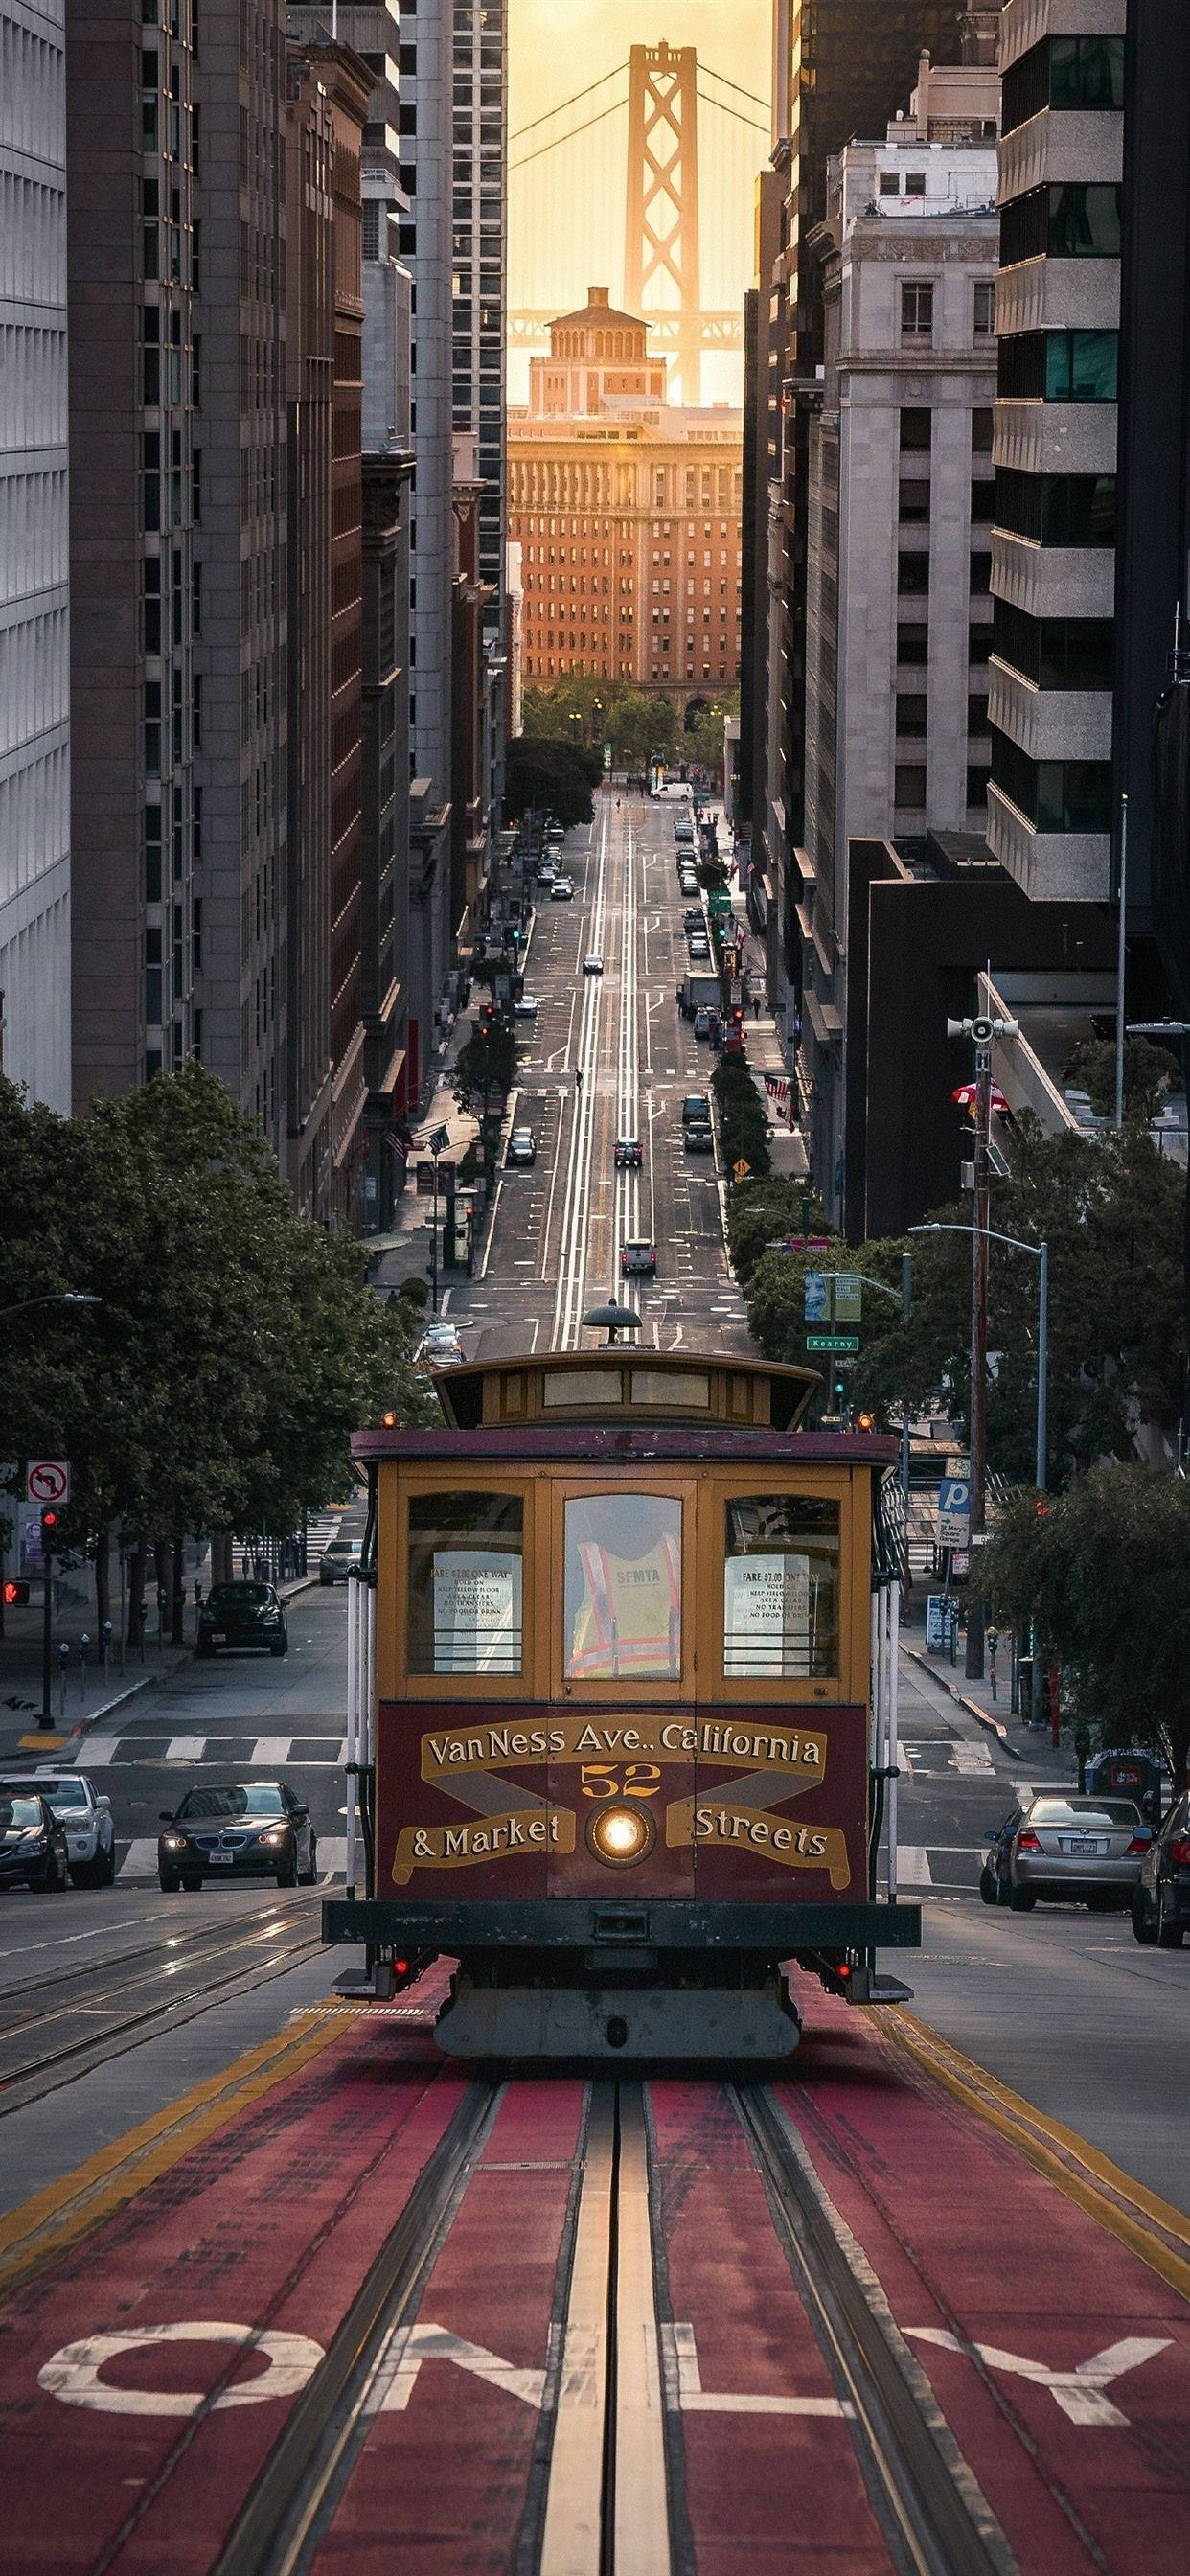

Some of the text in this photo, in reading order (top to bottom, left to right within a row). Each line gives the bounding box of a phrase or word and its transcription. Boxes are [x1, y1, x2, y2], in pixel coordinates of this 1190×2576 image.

[812, 1339, 853, 1349] Kearny
[430, 1569, 449, 1578] FARE
[471, 1570, 488, 1578] ONE
[491, 1570, 508, 1578] WAY
[616, 1569, 661, 1583] SFMTA
[743, 1573, 762, 1582] FARE
[764, 1573, 782, 1582] $7.00
[785, 1573, 800, 1582] ONE
[428, 1736, 483, 1765] Van
[489, 1727, 565, 1758] Ness
[661, 1723, 821, 1765] California
[580, 1764, 661, 1798] 52
[414, 1815, 561, 1856] & Market
[694, 1809, 829, 1856] Streets
[36, 2321, 1176, 2426] ONLY
